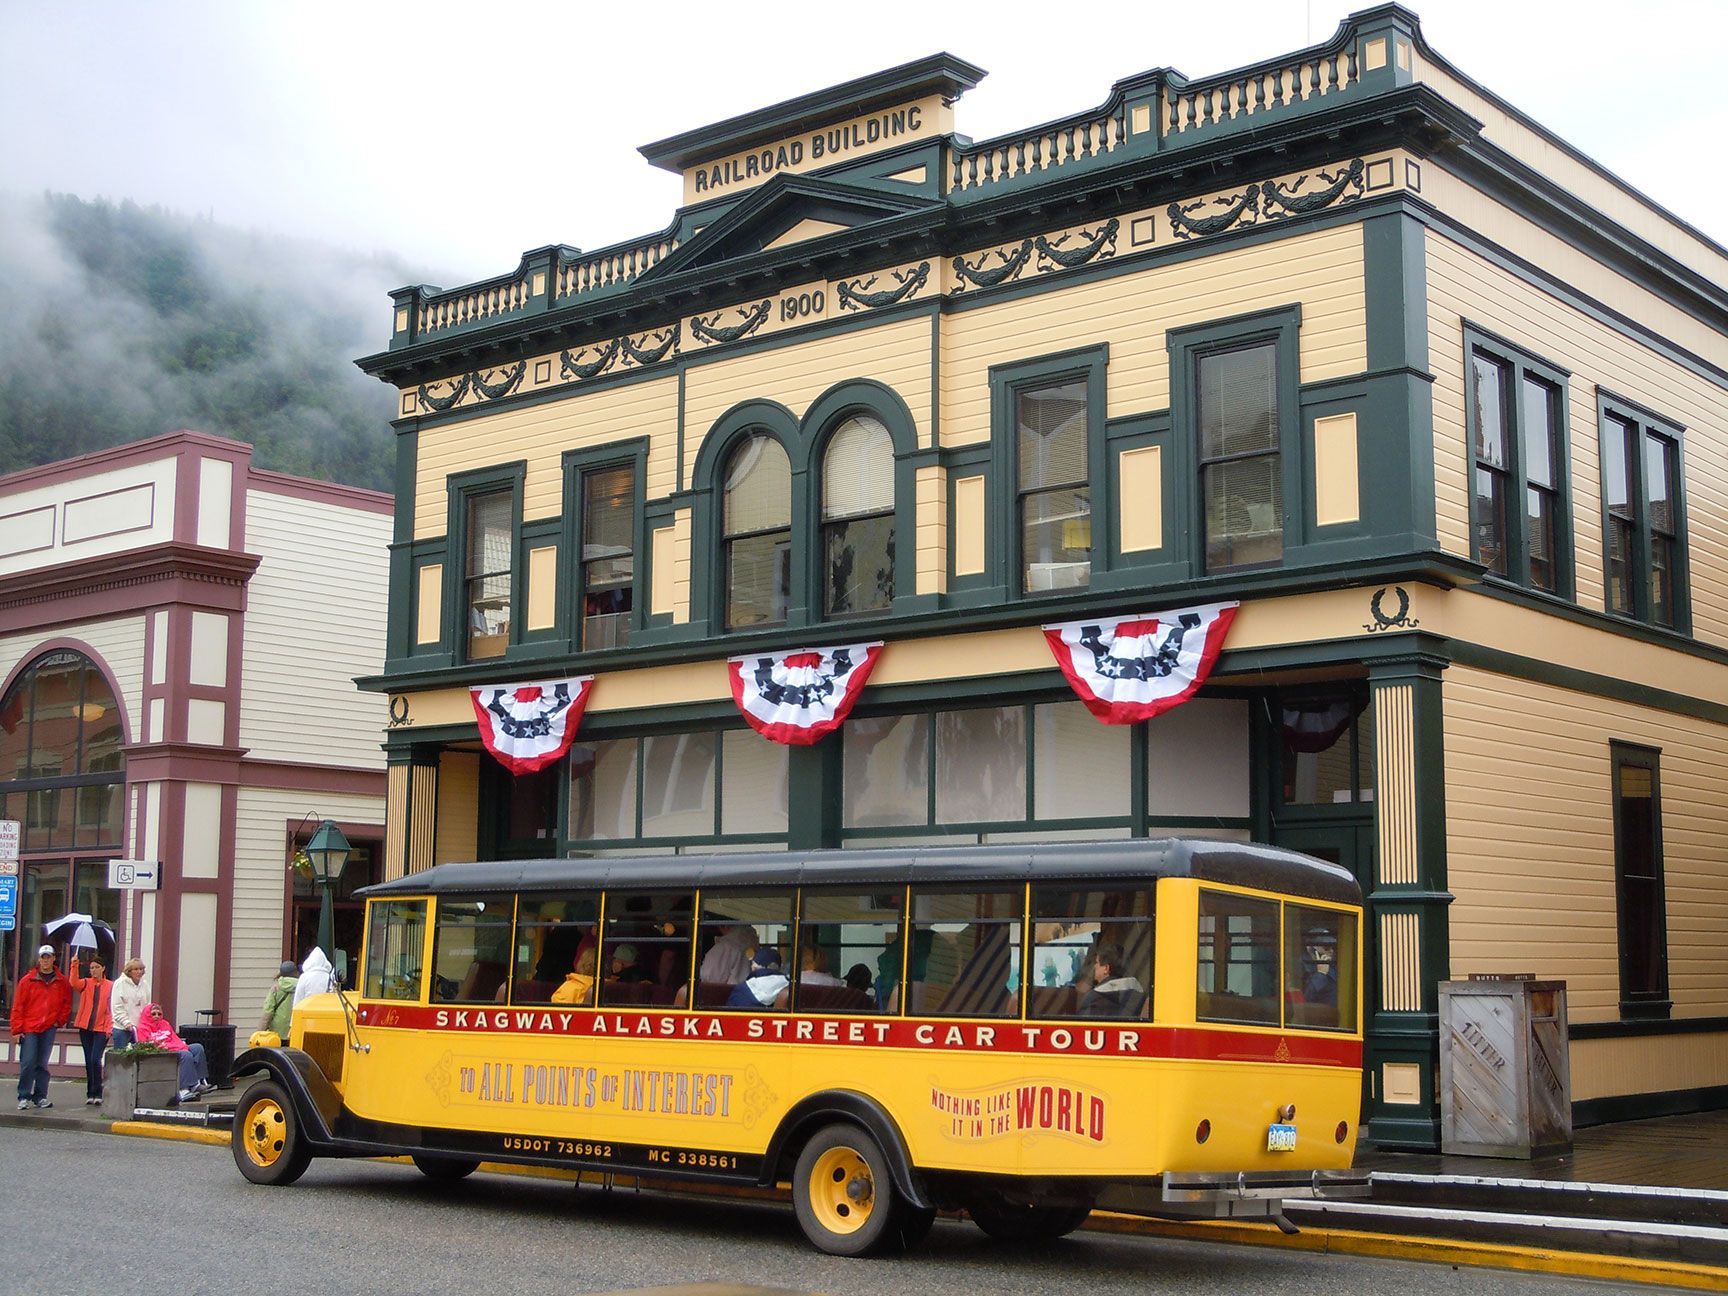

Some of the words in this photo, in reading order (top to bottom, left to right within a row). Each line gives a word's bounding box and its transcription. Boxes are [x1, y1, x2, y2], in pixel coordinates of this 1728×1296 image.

[695, 140, 804, 193] RAILROAD
[780, 290, 825, 322] 1900
[2, 823, 13, 832] NO
[436, 1010, 573, 1031] SKAGWAY
[592, 1015, 724, 1037] ALASKA
[747, 1020, 890, 1042] STREET
[915, 1024, 997, 1046] CAR
[1022, 1028, 1141, 1051] TOUR
[460, 1067, 476, 1093] TO
[478, 1063, 514, 1103] ALL
[521, 1065, 597, 1108] POINTS
[601, 1075, 618, 1102] OF
[622, 1070, 734, 1117] INTEREST
[931, 1088, 981, 1117] NOTHING
[987, 1091, 1011, 1114] LIKE
[952, 1118, 964, 1137] IT
[971, 1119, 983, 1138] IN
[990, 1114, 1010, 1136] THE
[1015, 1085, 1105, 1143] WORLD
[503, 1137, 551, 1151] USDOT
[557, 1141, 613, 1157] 736962
[648, 1150, 671, 1163] MC
[678, 1152, 738, 1169] 338561
